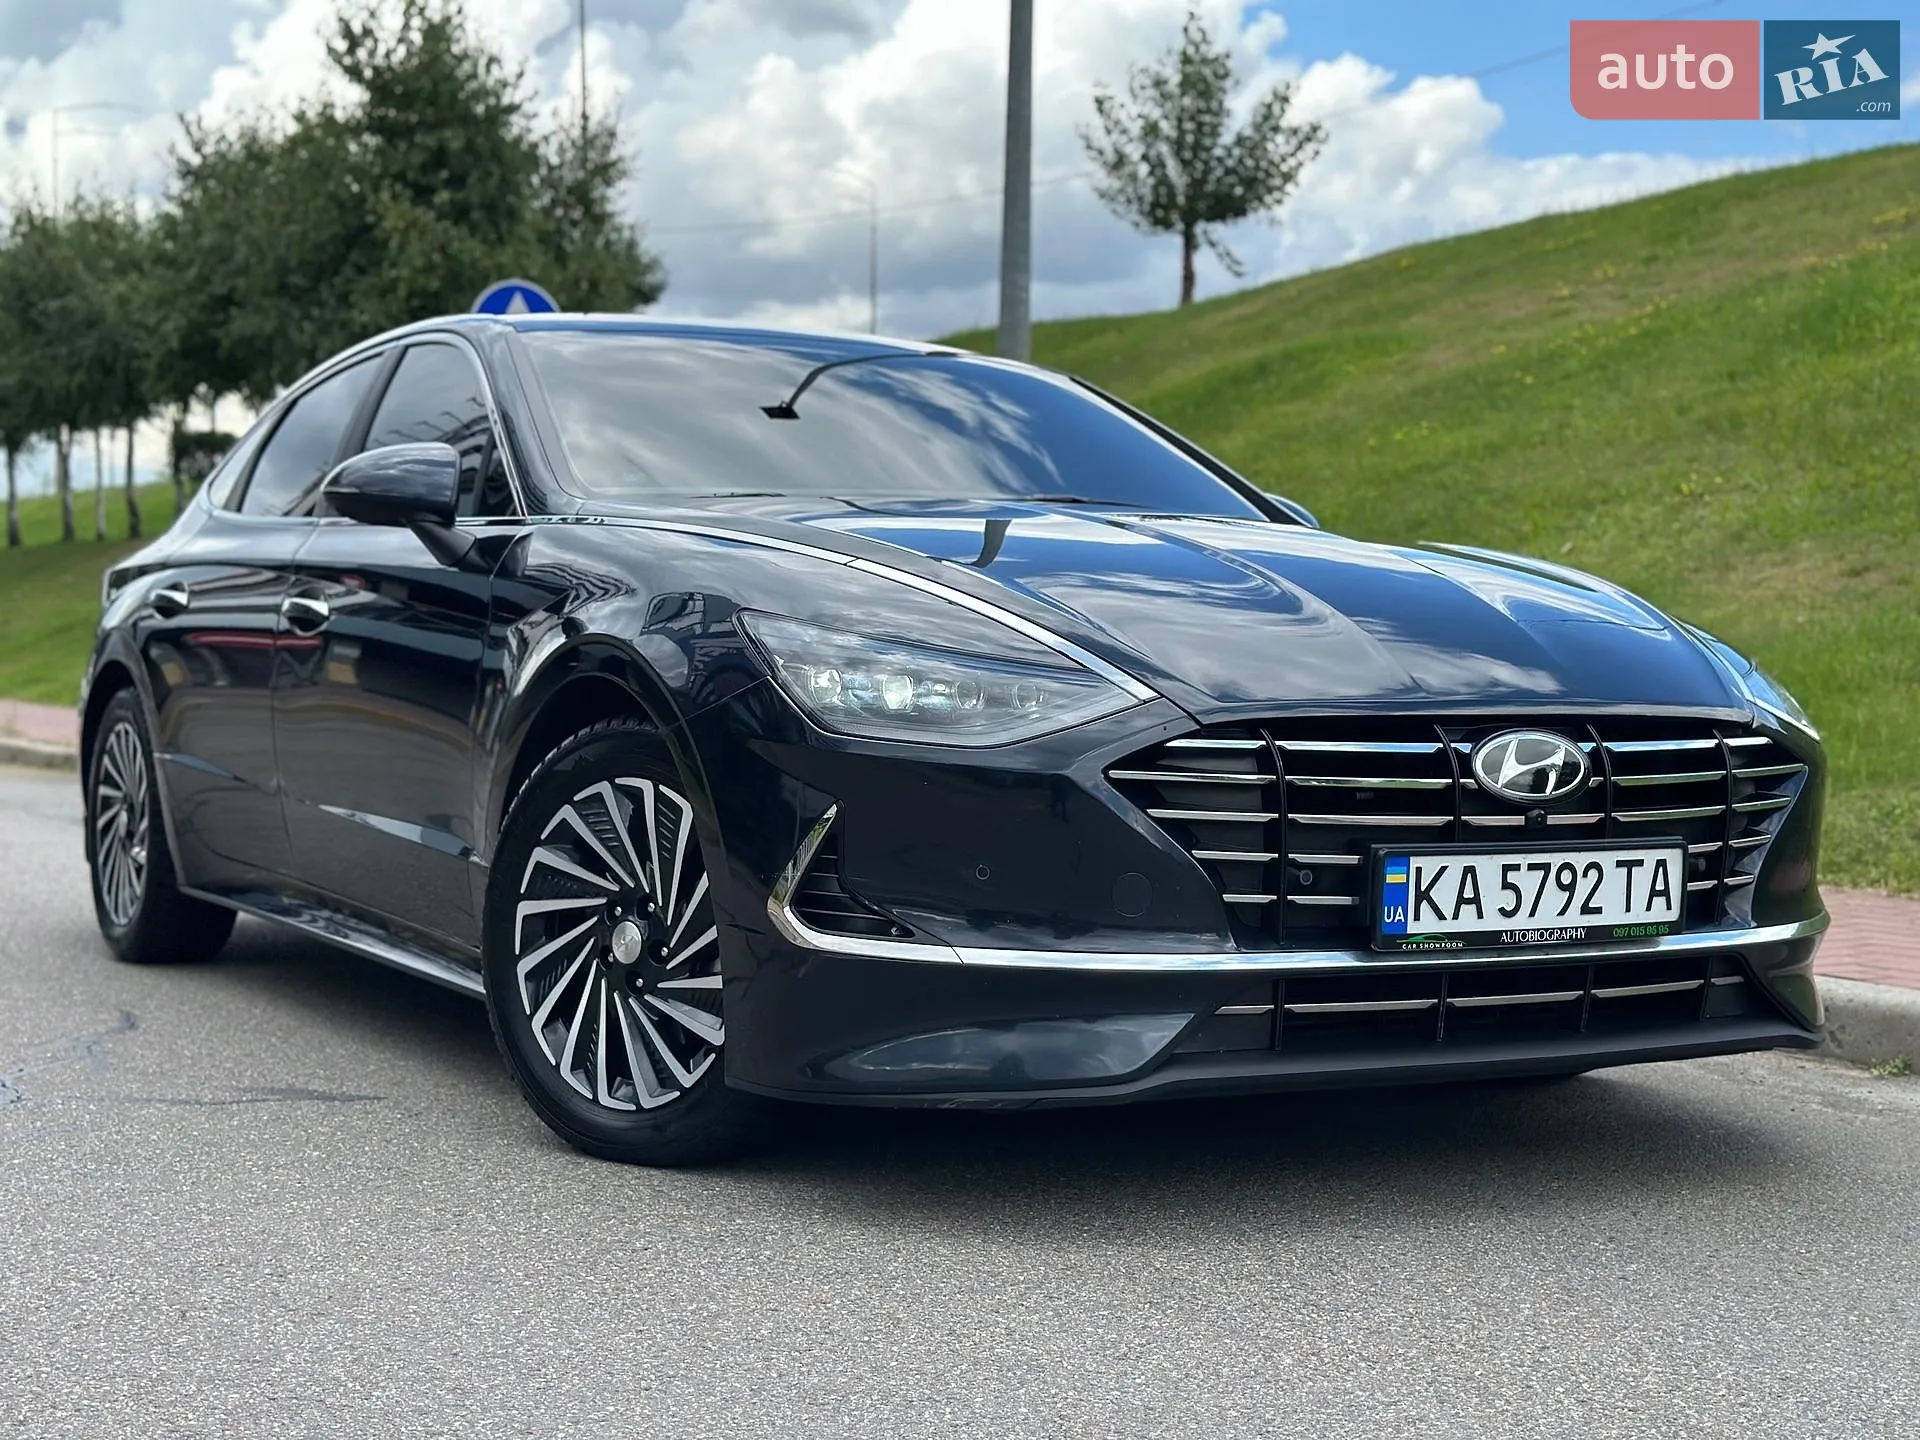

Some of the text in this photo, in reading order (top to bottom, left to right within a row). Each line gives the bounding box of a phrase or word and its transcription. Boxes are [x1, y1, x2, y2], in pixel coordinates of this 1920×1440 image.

[1413, 858, 1673, 922] KA 5792 TA
[1384, 905, 1405, 923] UA
[1500, 928, 1587, 943] AUTOBIOGRAPHY
[1613, 928, 1628, 937] 097
